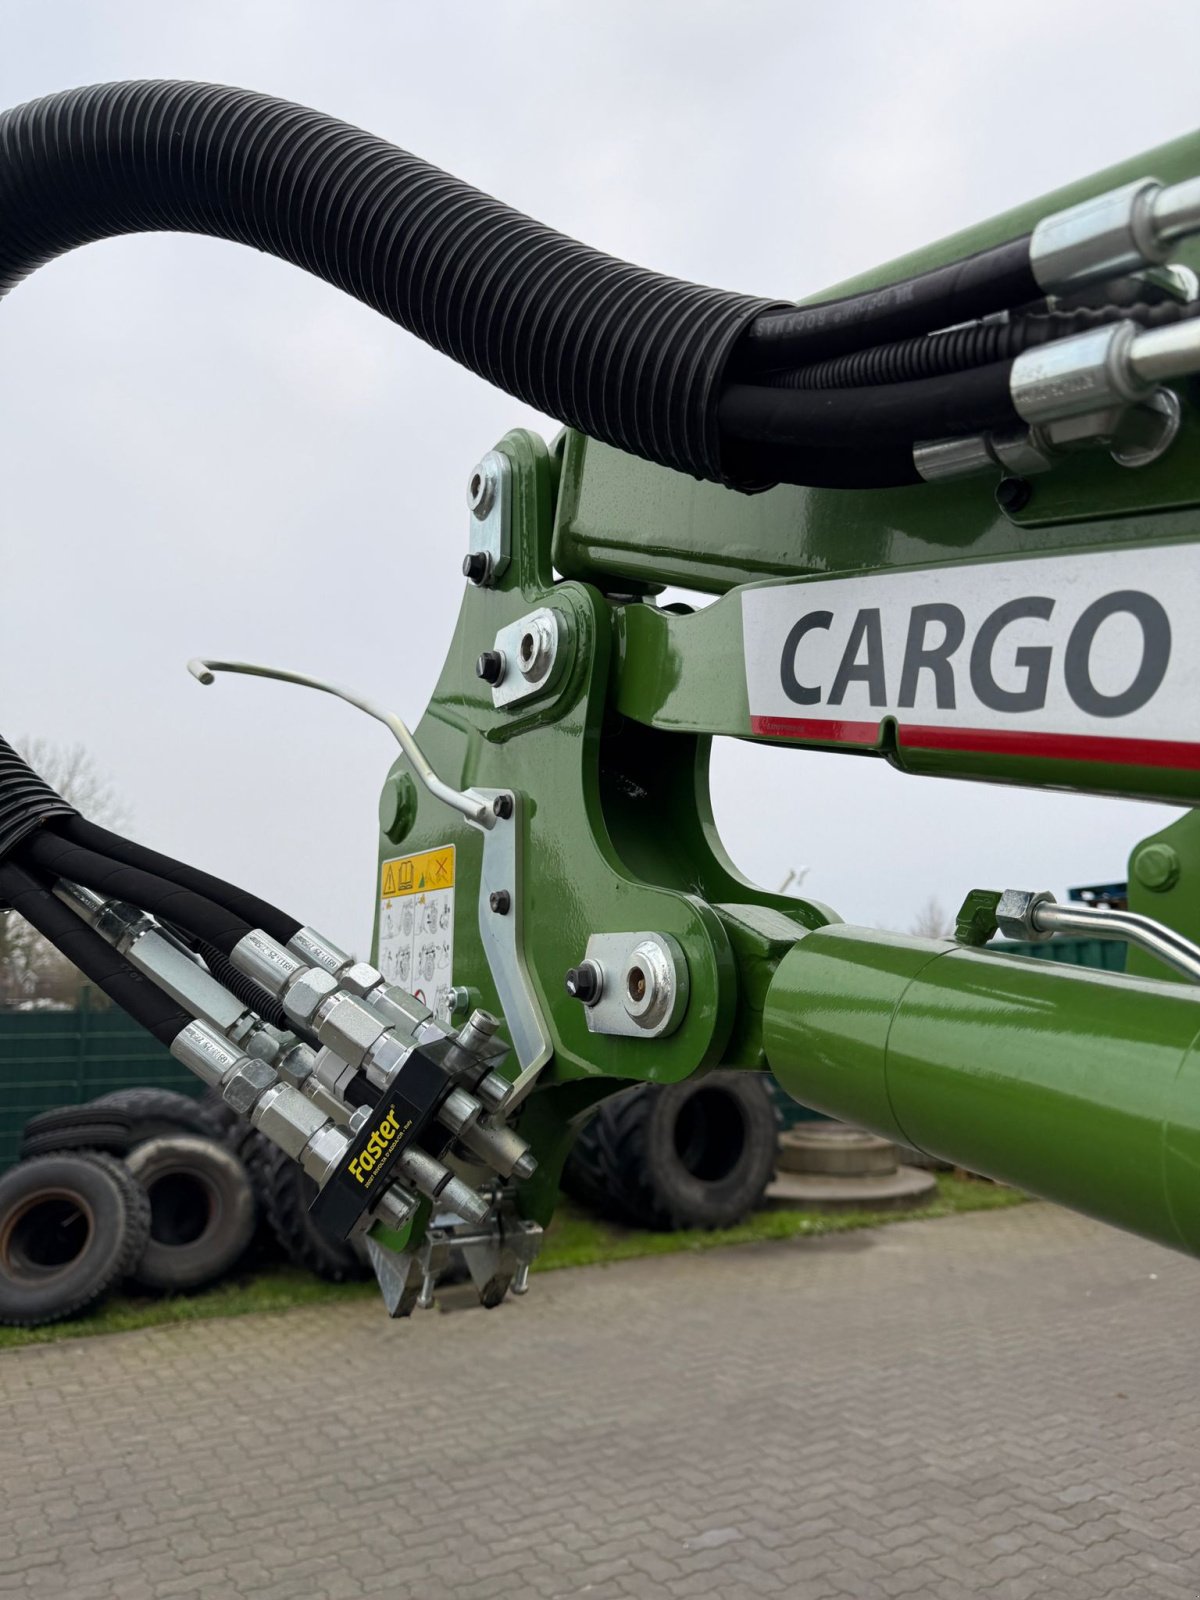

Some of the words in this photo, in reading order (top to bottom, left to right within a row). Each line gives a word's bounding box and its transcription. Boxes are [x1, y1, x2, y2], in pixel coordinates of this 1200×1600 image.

[750, 310, 827, 337] ROCKMAS
[780, 589, 1172, 718] CARGO
[348, 1109, 400, 1183] Faster
